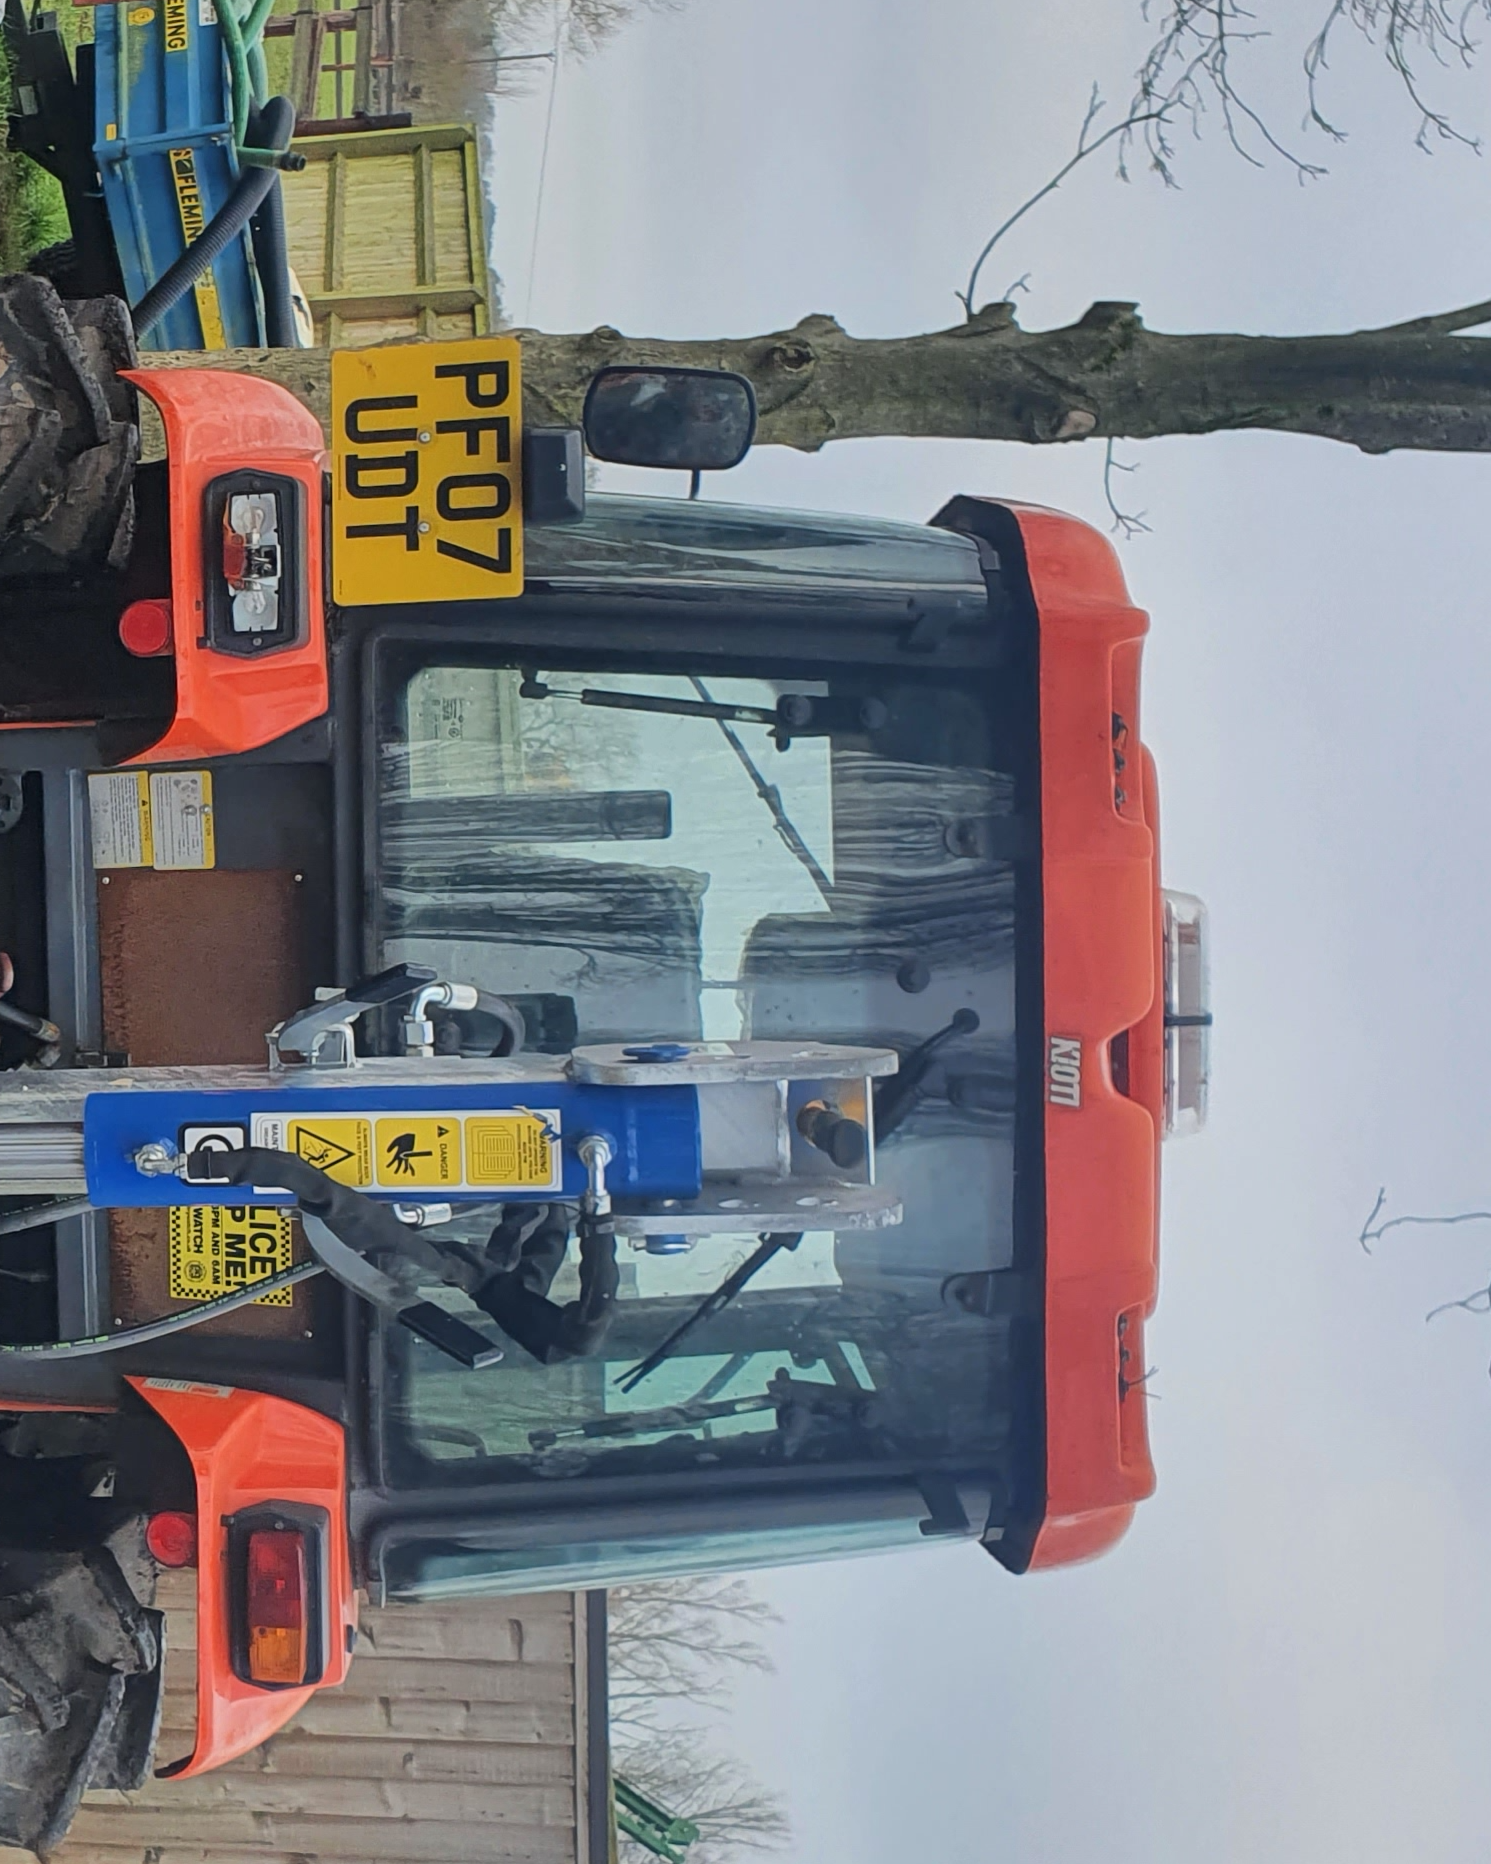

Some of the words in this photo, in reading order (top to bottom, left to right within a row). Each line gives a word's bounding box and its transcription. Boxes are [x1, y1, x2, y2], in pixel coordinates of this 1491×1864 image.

[344, 395, 419, 551] UDT
[435, 360, 512, 574] PF07
[440, 1143, 448, 1180] DANGER
[193, 1208, 203, 1254] WATCH
[212, 1232, 220, 1256] AND
[212, 1260, 220, 1284] 6AM
[224, 1233, 246, 1288] ME!
